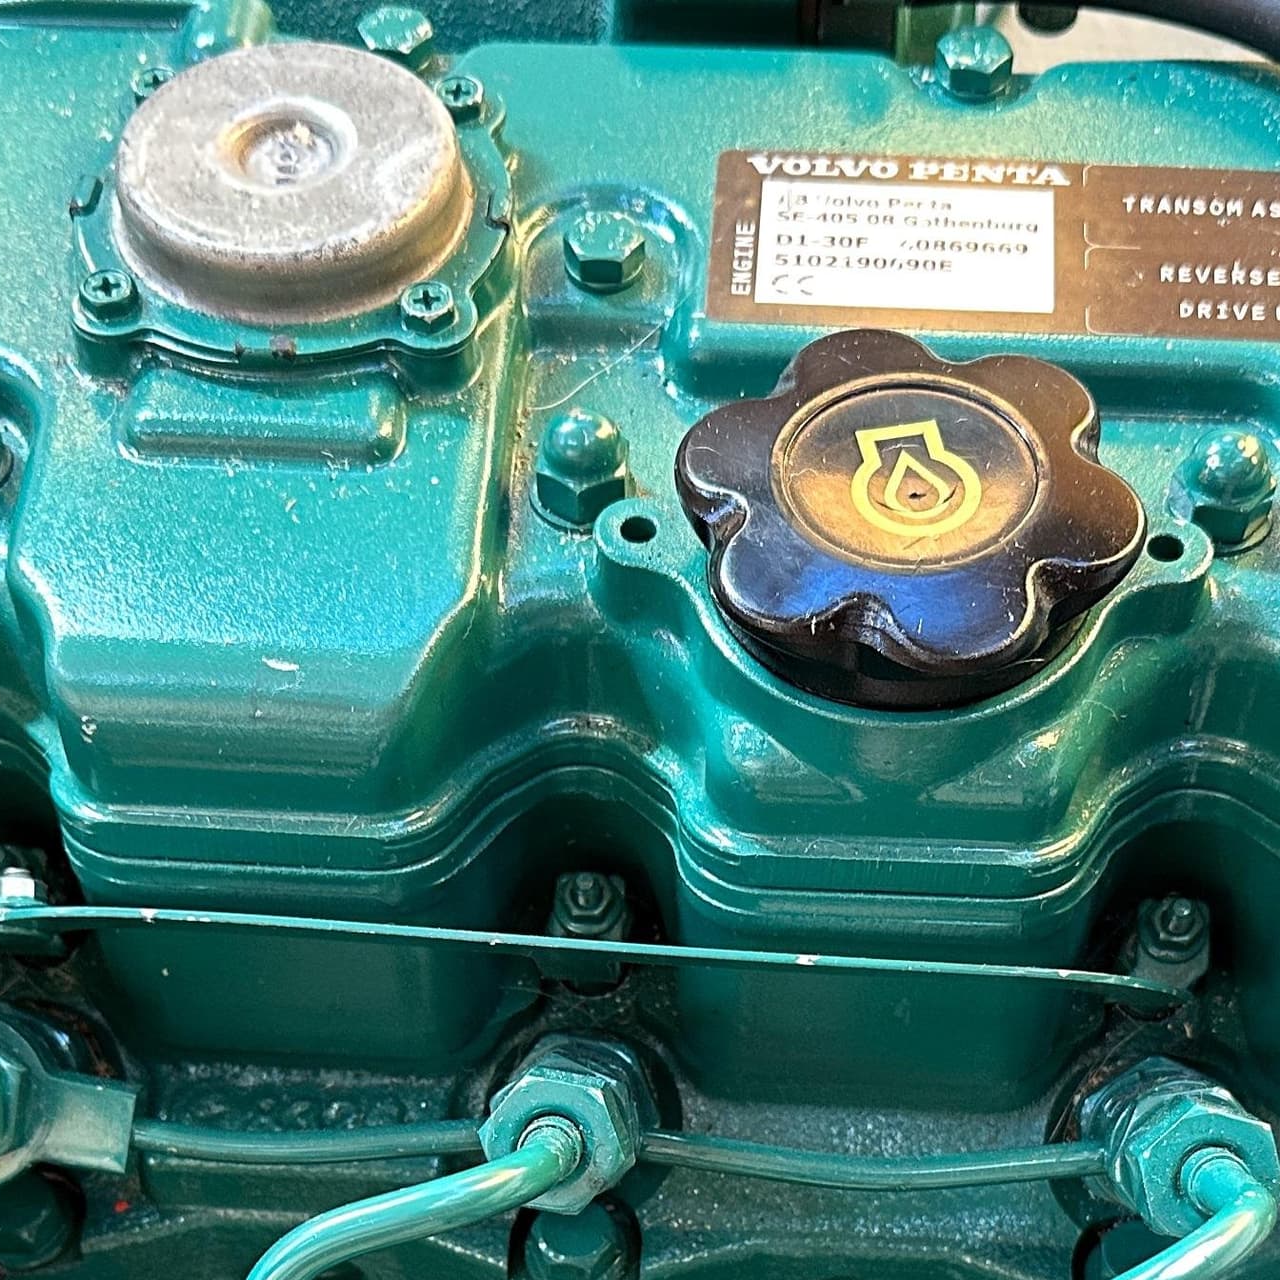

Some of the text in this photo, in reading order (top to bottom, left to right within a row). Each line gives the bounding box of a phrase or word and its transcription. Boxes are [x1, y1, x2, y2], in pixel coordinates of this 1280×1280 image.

[747, 156, 1071, 186] VOLVO PENTA
[1122, 196, 1244, 217] TRANSOM
[731, 219, 755, 295] ENGINE
[1179, 301, 1266, 322] DRIVE
